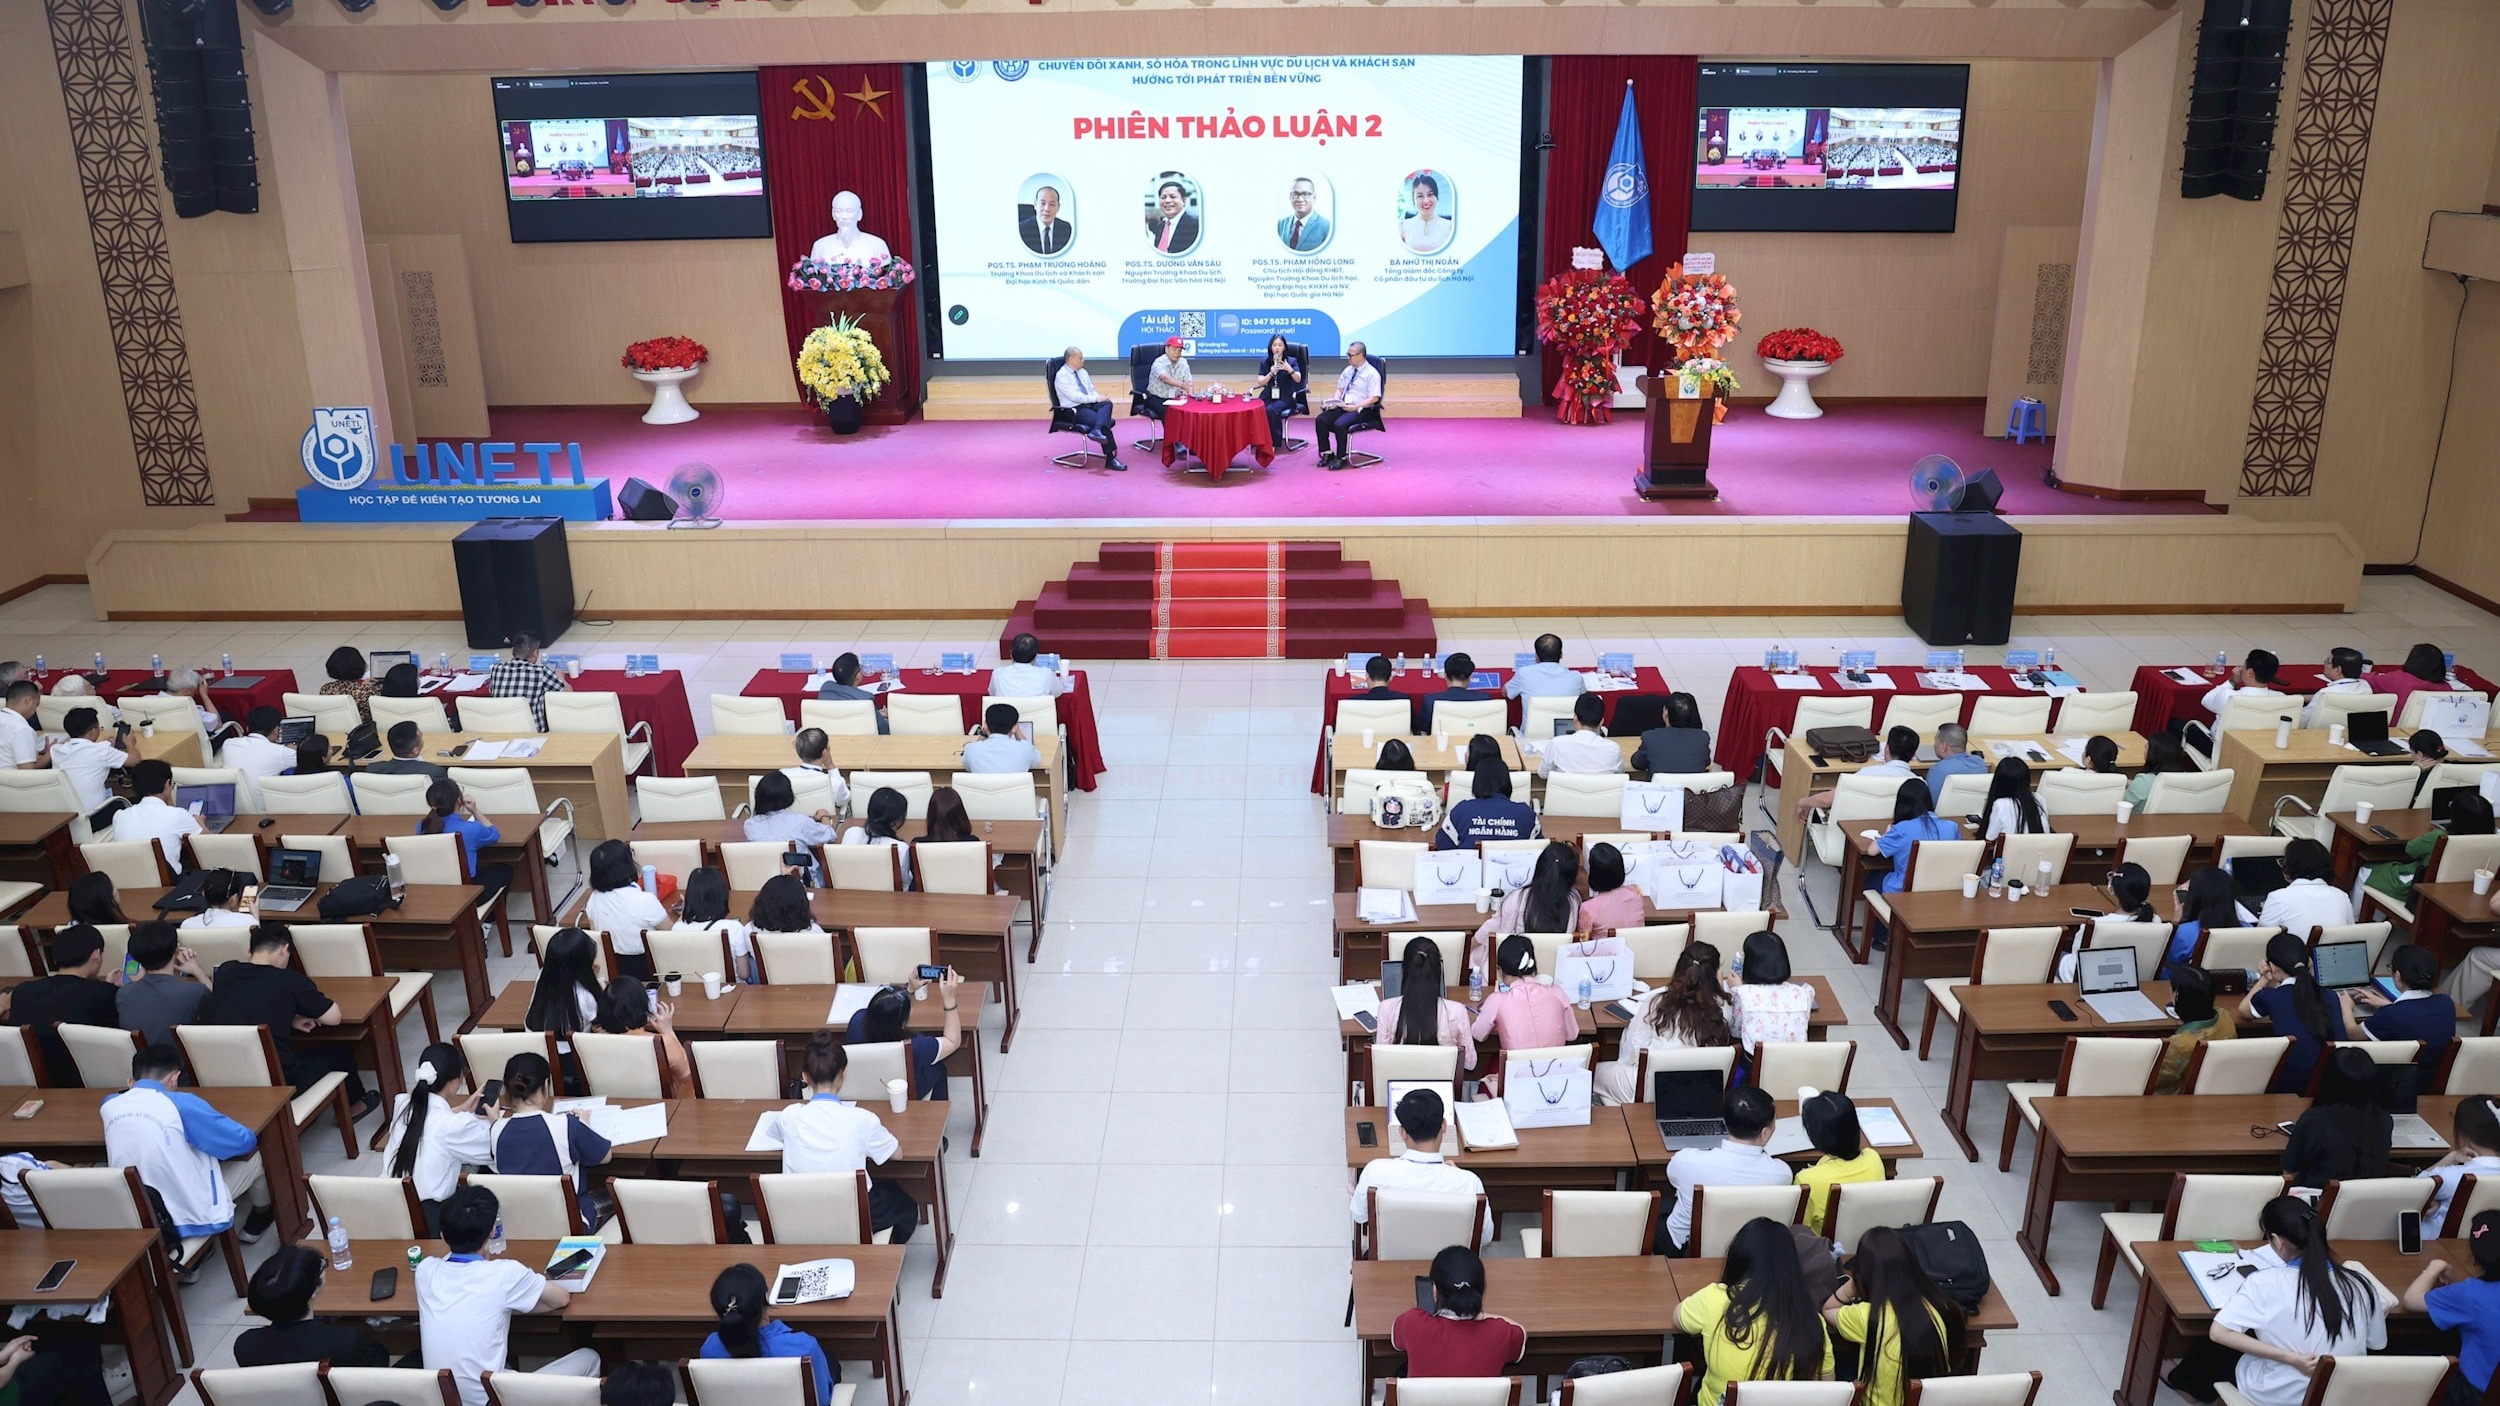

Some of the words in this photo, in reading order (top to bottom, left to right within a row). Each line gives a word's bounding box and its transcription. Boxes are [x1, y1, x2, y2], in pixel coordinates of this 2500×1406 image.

[1109, 60, 1144, 70] XANH,
[1164, 57, 1188, 69] HÓA
[1191, 59, 1230, 68] TRONG
[1232, 57, 1258, 68] LĨNH
[1261, 58, 1284, 71] VỰC
[1287, 58, 1302, 68] DU
[1304, 58, 1329, 70] LỊCH
[1332, 56, 1348, 67] VÀ
[1350, 56, 1390, 67] KHÁCH
[1392, 58, 1415, 70] SẠN
[1133, 73, 1174, 84] HƯỚNG
[1177, 73, 1194, 84] TỚI
[1197, 73, 1226, 84] PHÁT
[1228, 71, 1261, 84] TRIỂN
[1264, 71, 1287, 83] BỀN
[1289, 72, 1321, 83] VỮNG
[1073, 110, 1169, 139] PHIÊN
[1176, 107, 1266, 138] THẢO
[1273, 109, 1357, 146] LUẬN
[1365, 115, 1383, 137] 2
[1140, 314, 1156, 324] TÀI
[1157, 314, 1176, 326] LIỆU
[1141, 325, 1154, 335] HỘI
[1155, 325, 1175, 334] THẢO
[331, 420, 360, 428] UNETI
[389, 441, 586, 486] UNETI
[348, 494, 374, 506] HỌC
[376, 493, 399, 506] TẬP
[401, 492, 418, 504] ĐỂ
[420, 492, 447, 504] KIẾN
[449, 494, 474, 506] TẠO
[476, 494, 520, 504] TƯƠNG
[522, 494, 541, 504] LAI
[1472, 816, 1486, 825] TÀI
[1488, 816, 1515, 826] CHÍNH
[1468, 826, 1493, 835] NGÂN
[1494, 826, 1519, 837] HÀNG
